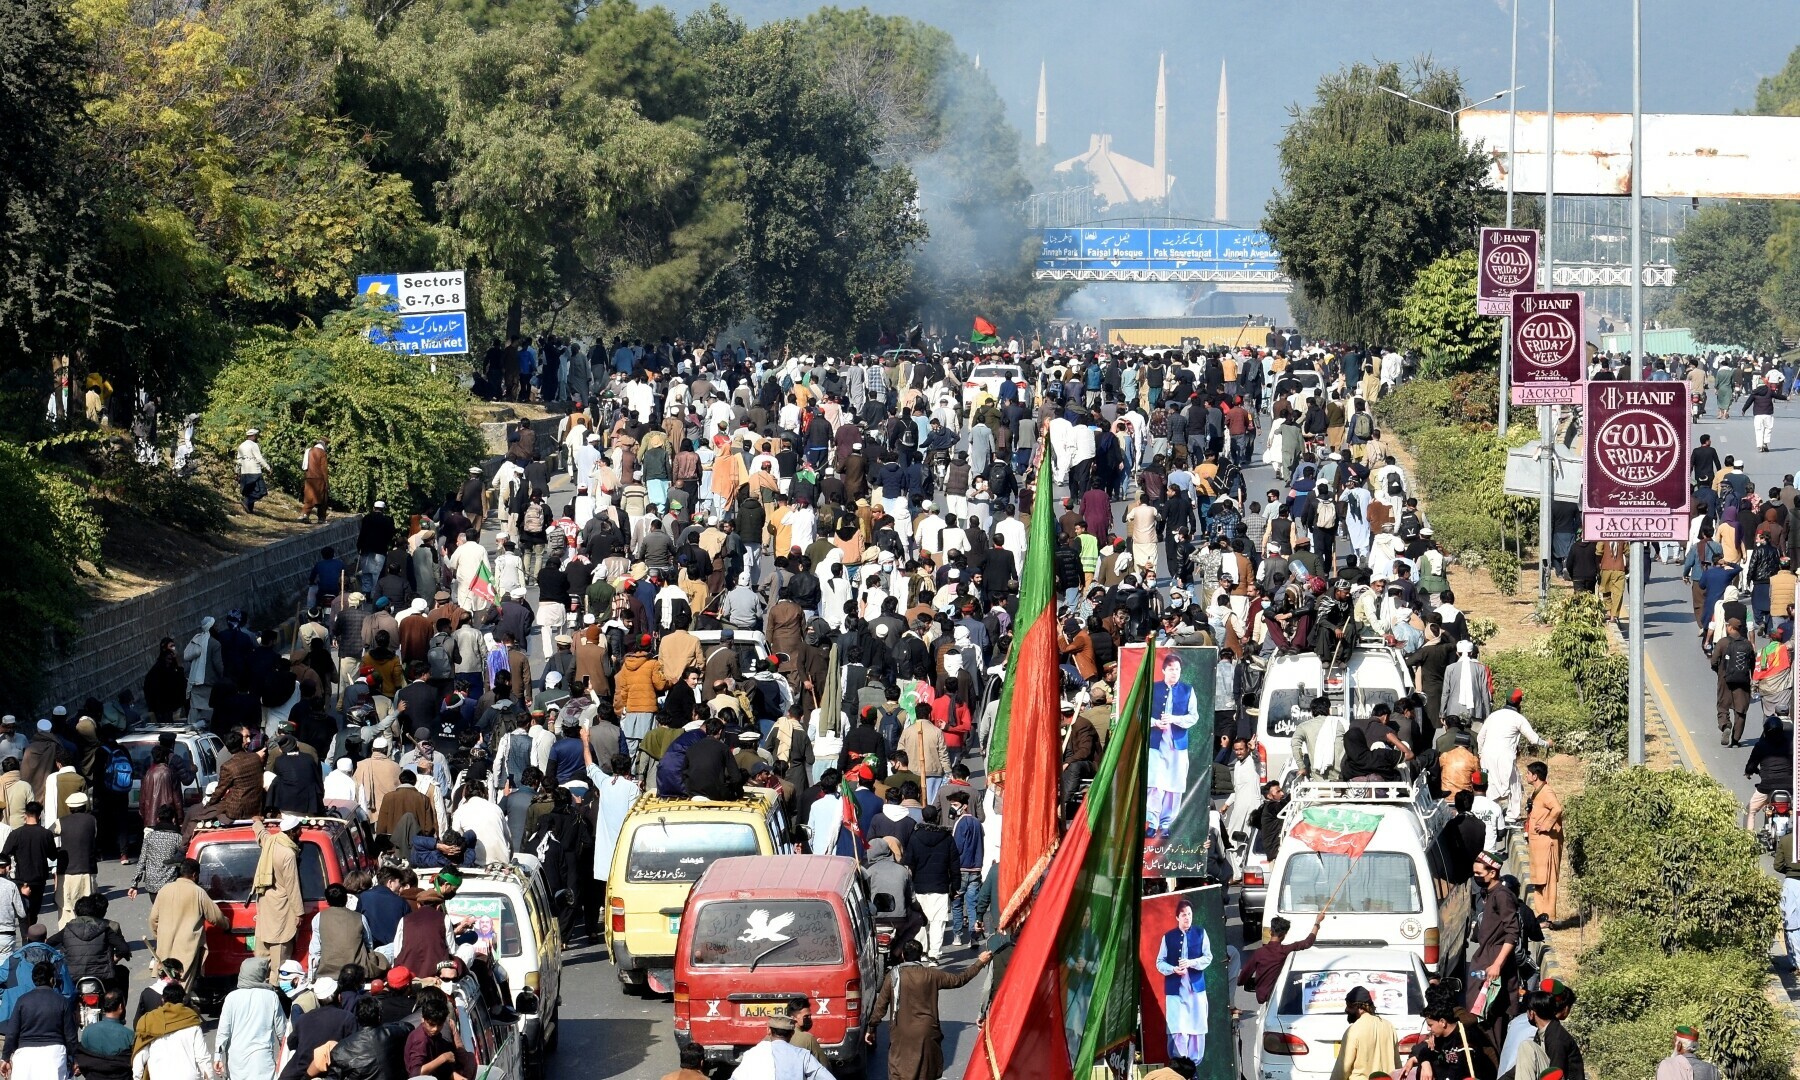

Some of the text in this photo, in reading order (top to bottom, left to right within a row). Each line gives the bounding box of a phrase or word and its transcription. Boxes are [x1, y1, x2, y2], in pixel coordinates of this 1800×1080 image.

[1114, 232, 1130, 247] فیصل
[1189, 233, 1204, 248] پاک
[1503, 234, 1531, 244] HANIF
[1041, 248, 1078, 257] Jinnah Park
[1087, 248, 1143, 258] Faisal Mosque
[1153, 248, 1168, 257] Pak
[1223, 248, 1278, 258] Jinnah Avenue
[1489, 252, 1529, 266] GOLD
[1491, 265, 1527, 275] FRIDAY
[403, 276, 463, 289] Sectors
[1497, 274, 1521, 283] WEEK
[1484, 302, 1511, 311] JACK
[1538, 299, 1573, 310] HANIF
[407, 315, 461, 336] ستارہ مارکیٹ
[1522, 322, 1573, 339] GOLD
[421, 337, 463, 350] Market
[1525, 340, 1569, 353] FRIDAY
[1532, 351, 1564, 364] WEEK
[1518, 387, 1576, 399] JACKPOT
[1626, 391, 1676, 406] HANIF
[1601, 423, 1674, 448] GOLD
[1604, 448, 1671, 467] FRIDAY
[1616, 465, 1661, 481] WEEK
[1595, 517, 1679, 531] JACKPOT
[1155, 843, 1173, 855] عمران
